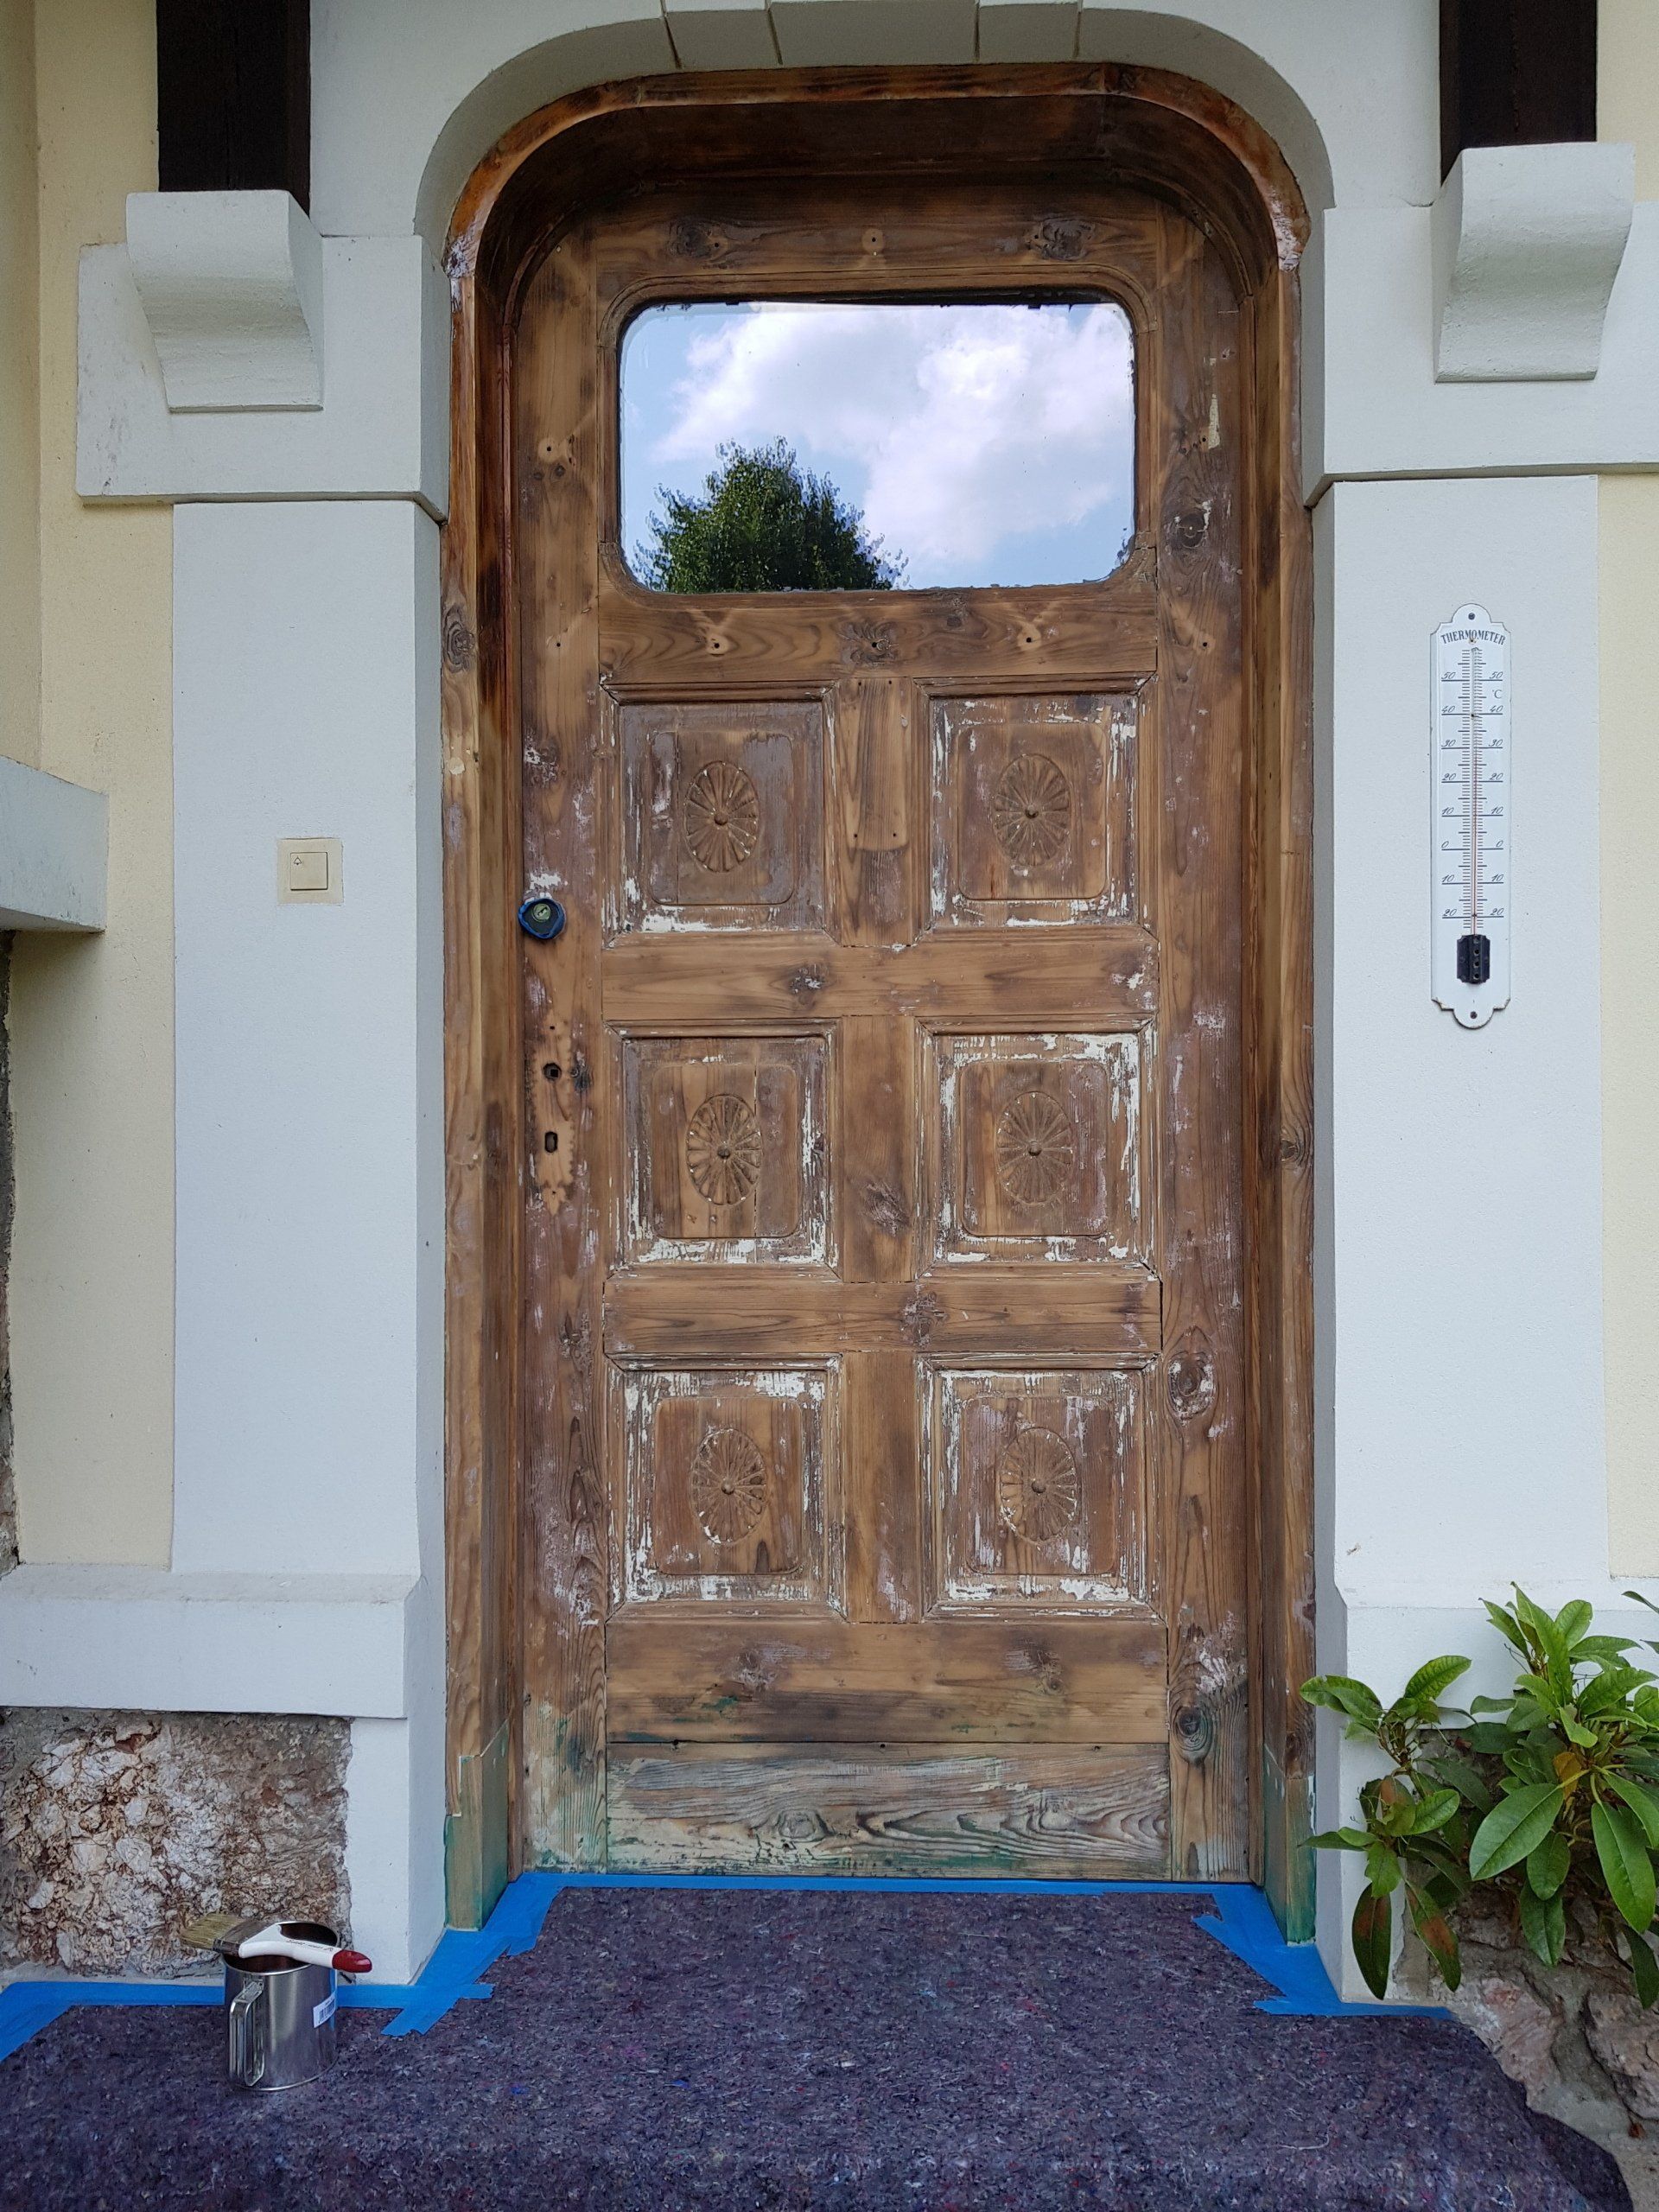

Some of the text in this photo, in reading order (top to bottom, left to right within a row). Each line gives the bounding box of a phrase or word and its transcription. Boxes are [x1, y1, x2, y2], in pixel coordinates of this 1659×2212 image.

[1440, 629, 1506, 645] THERMOMETER
[1441, 671, 1456, 680] 50
[1441, 739, 1456, 747] 30
[1488, 739, 1503, 747] 30
[1441, 772, 1456, 781] 20
[1491, 806, 1503, 815] 10
[1491, 874, 1504, 882] 10
[1442, 908, 1457, 917] 20
[1490, 907, 1504, 916] 20
